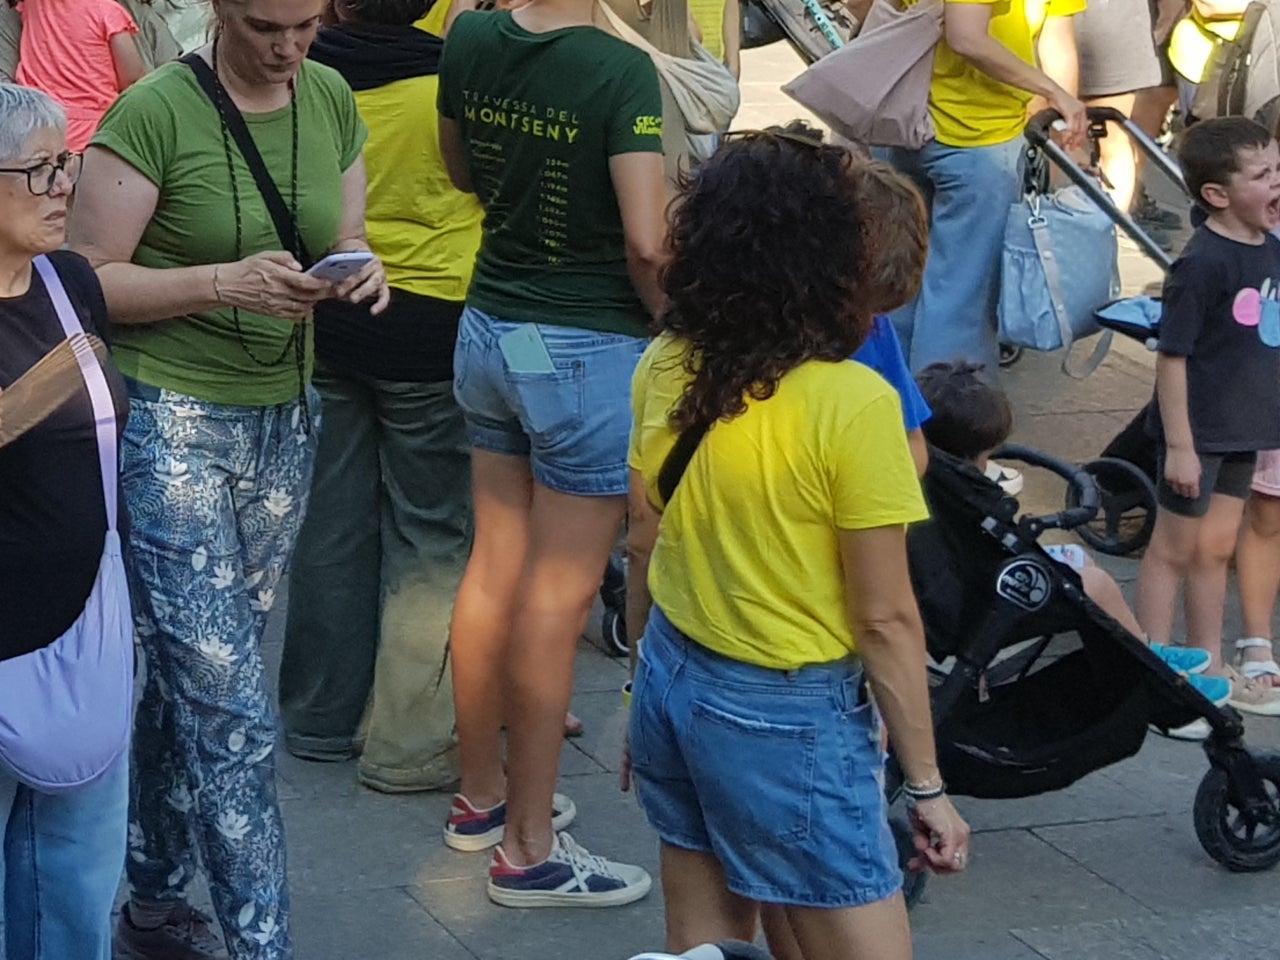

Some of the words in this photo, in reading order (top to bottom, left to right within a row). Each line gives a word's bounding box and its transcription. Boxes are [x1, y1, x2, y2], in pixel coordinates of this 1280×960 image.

[463, 90, 537, 115] TRAVESSA
[546, 107, 580, 125] DEL
[464, 105, 579, 144] MONTSENY
